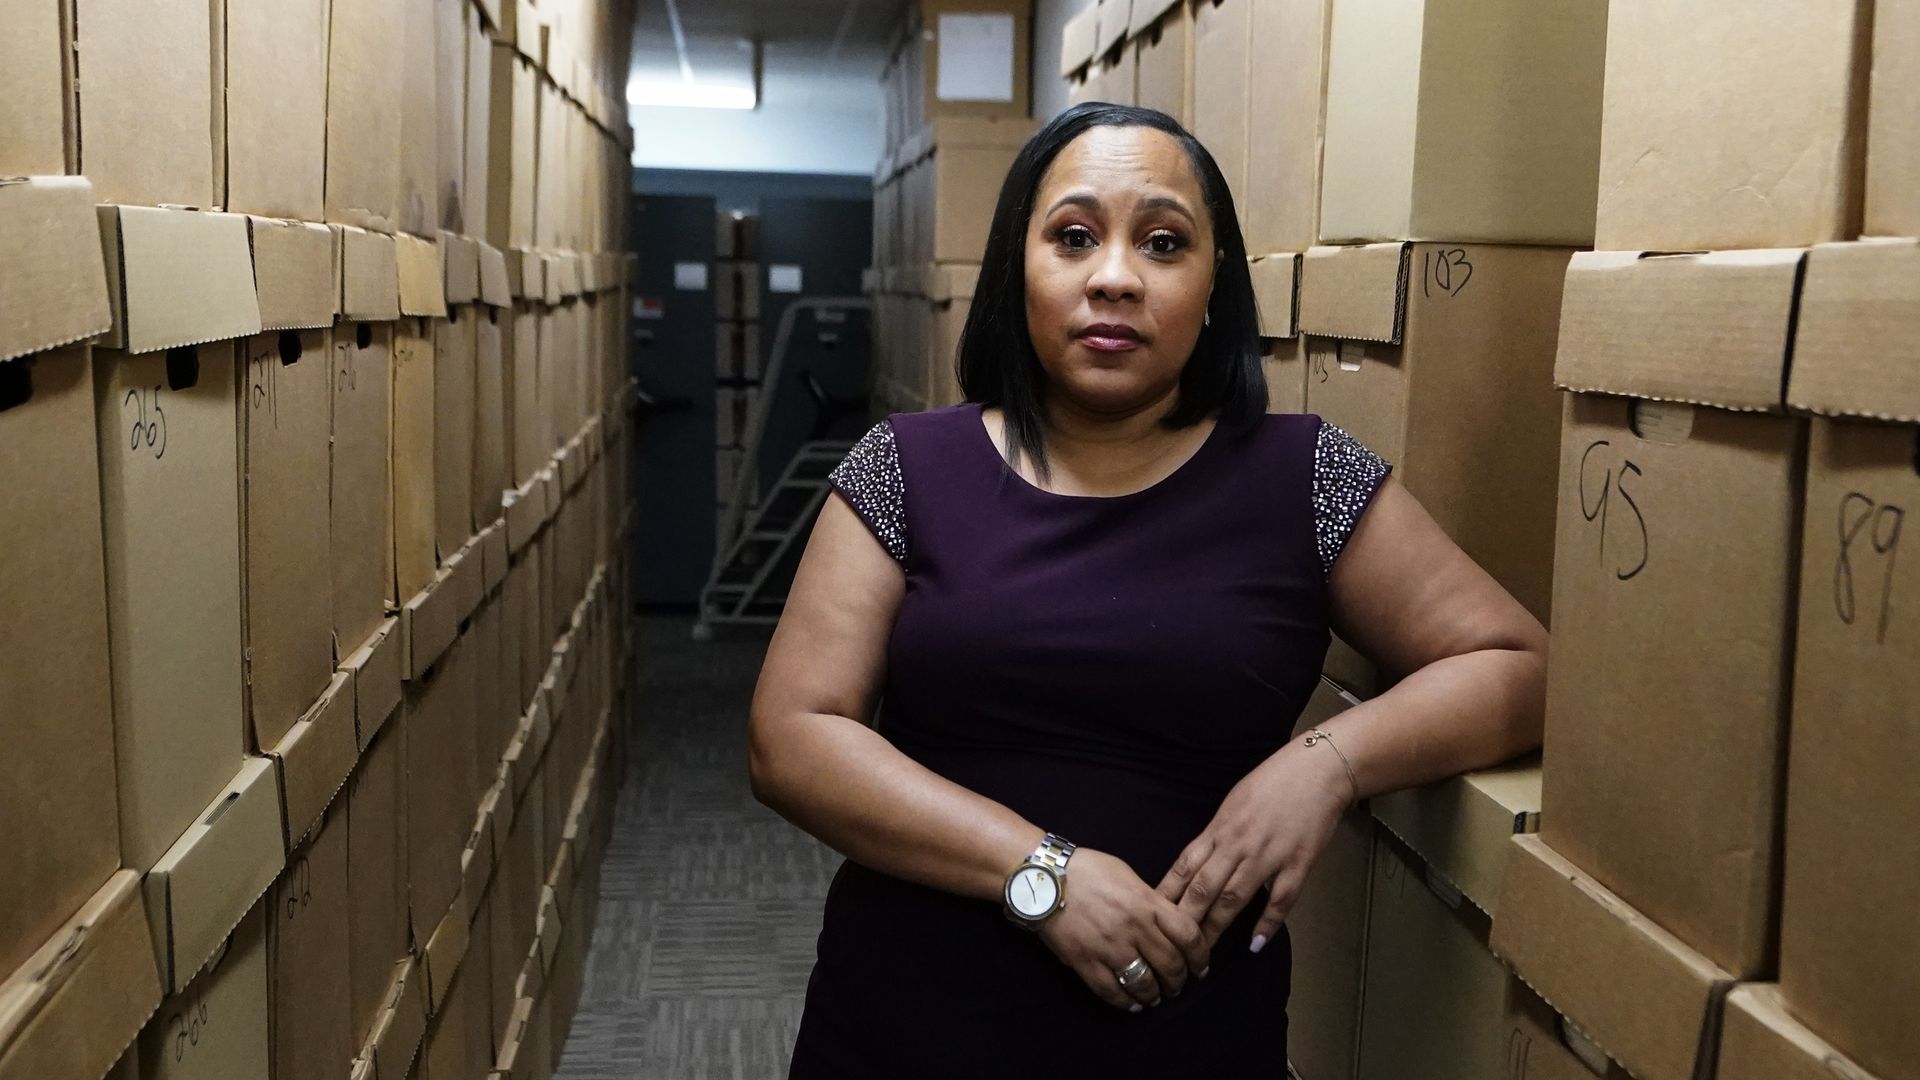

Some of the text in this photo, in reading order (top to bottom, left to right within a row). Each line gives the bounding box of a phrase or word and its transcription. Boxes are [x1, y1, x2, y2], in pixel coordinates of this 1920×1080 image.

[1424, 249, 1473, 298] 103
[125, 384, 167, 460] 265
[1580, 440, 1648, 581] 95
[1835, 492, 1906, 646] 89
